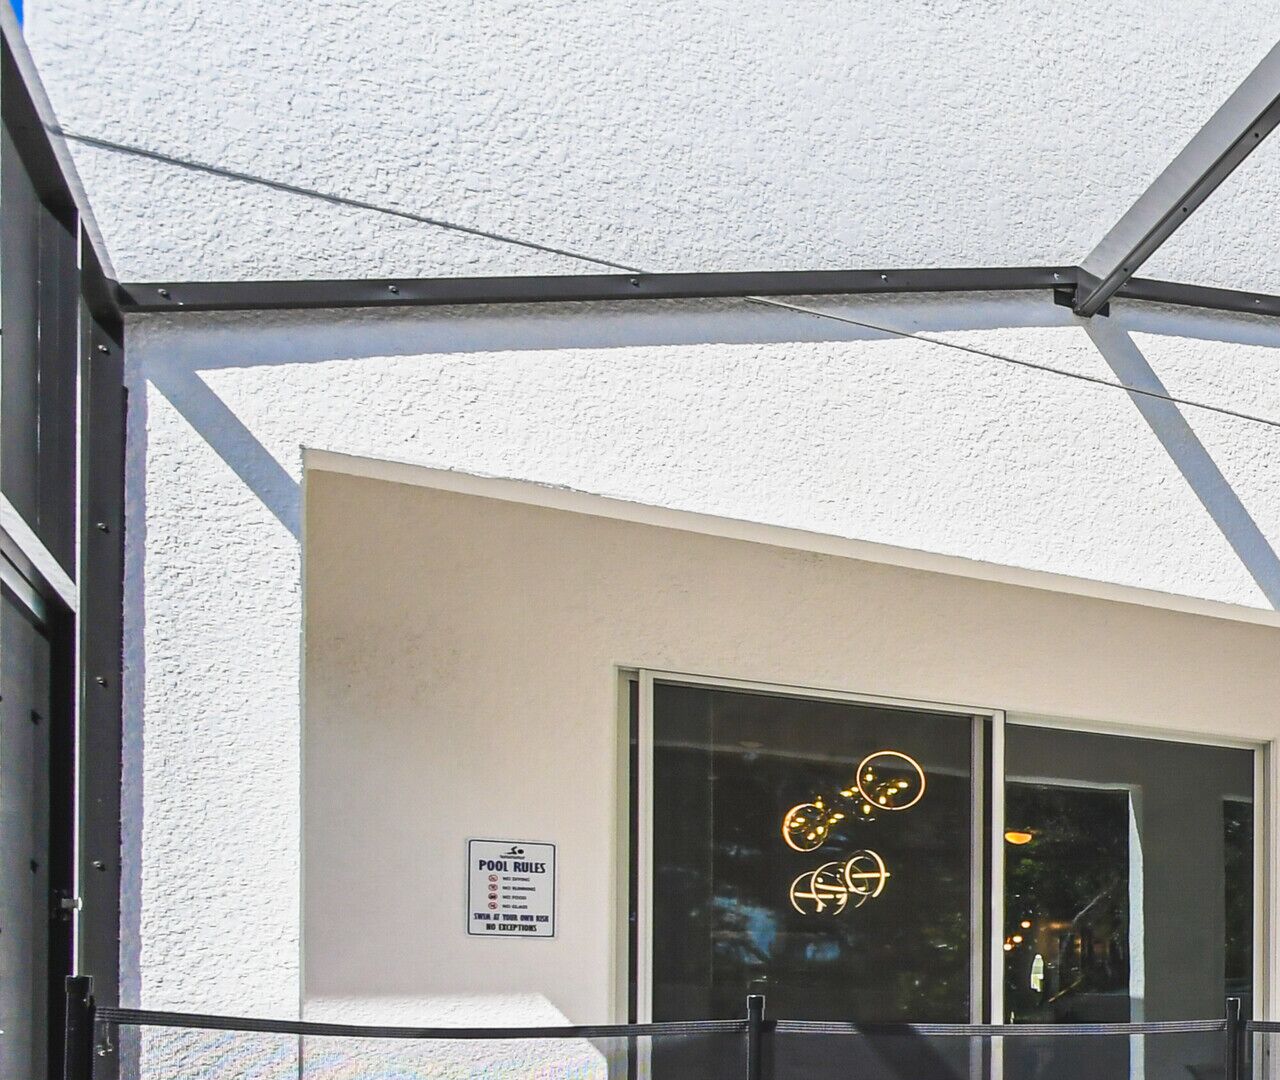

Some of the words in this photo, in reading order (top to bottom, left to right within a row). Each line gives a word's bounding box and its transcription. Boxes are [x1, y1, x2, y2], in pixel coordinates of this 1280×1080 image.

[479, 859, 509, 872] POOL
[513, 861, 546, 874] RULES
[474, 912, 491, 920] SWIM
[493, 913, 500, 921] AT
[502, 913, 518, 922] YOUR
[520, 914, 534, 922] OWN
[536, 915, 549, 923] RISK
[499, 923, 537, 932] EXCEPTIONS
